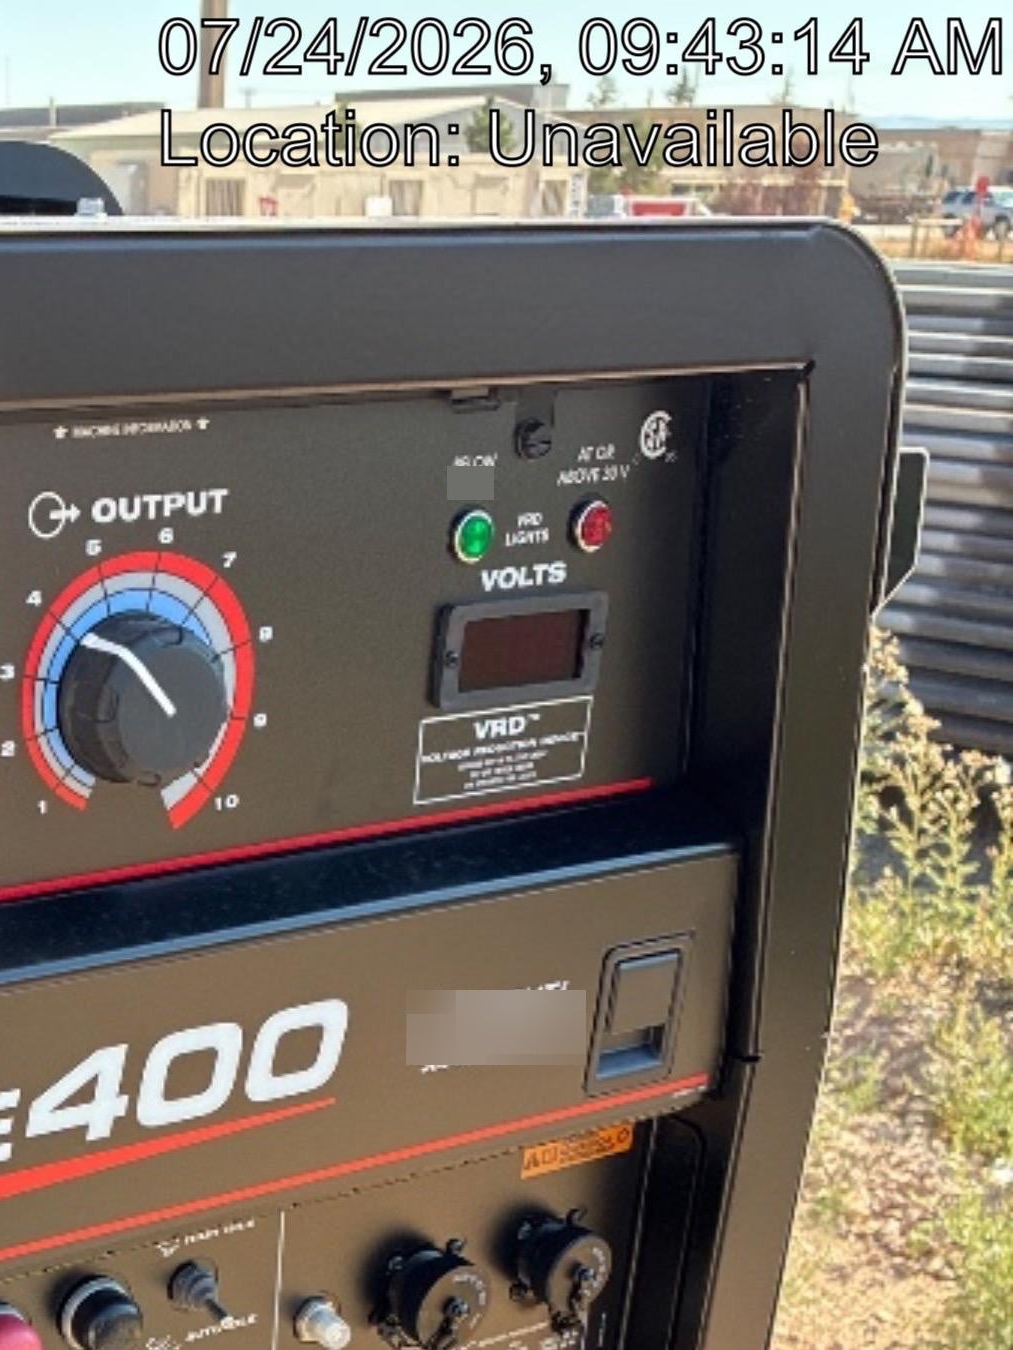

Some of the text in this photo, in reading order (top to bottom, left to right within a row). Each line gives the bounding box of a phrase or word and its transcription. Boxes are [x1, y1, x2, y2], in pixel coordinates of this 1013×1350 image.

[91, 488, 230, 524] OUTPUT
[158, 527, 174, 544] 6
[85, 539, 102, 556] 5
[222, 551, 238, 568] 7
[481, 560, 568, 592] VOLTS
[26, 590, 43, 607] 4
[0, 740, 16, 757] 2
[38, 800, 48, 814] 1
[214, 794, 240, 811] 10
